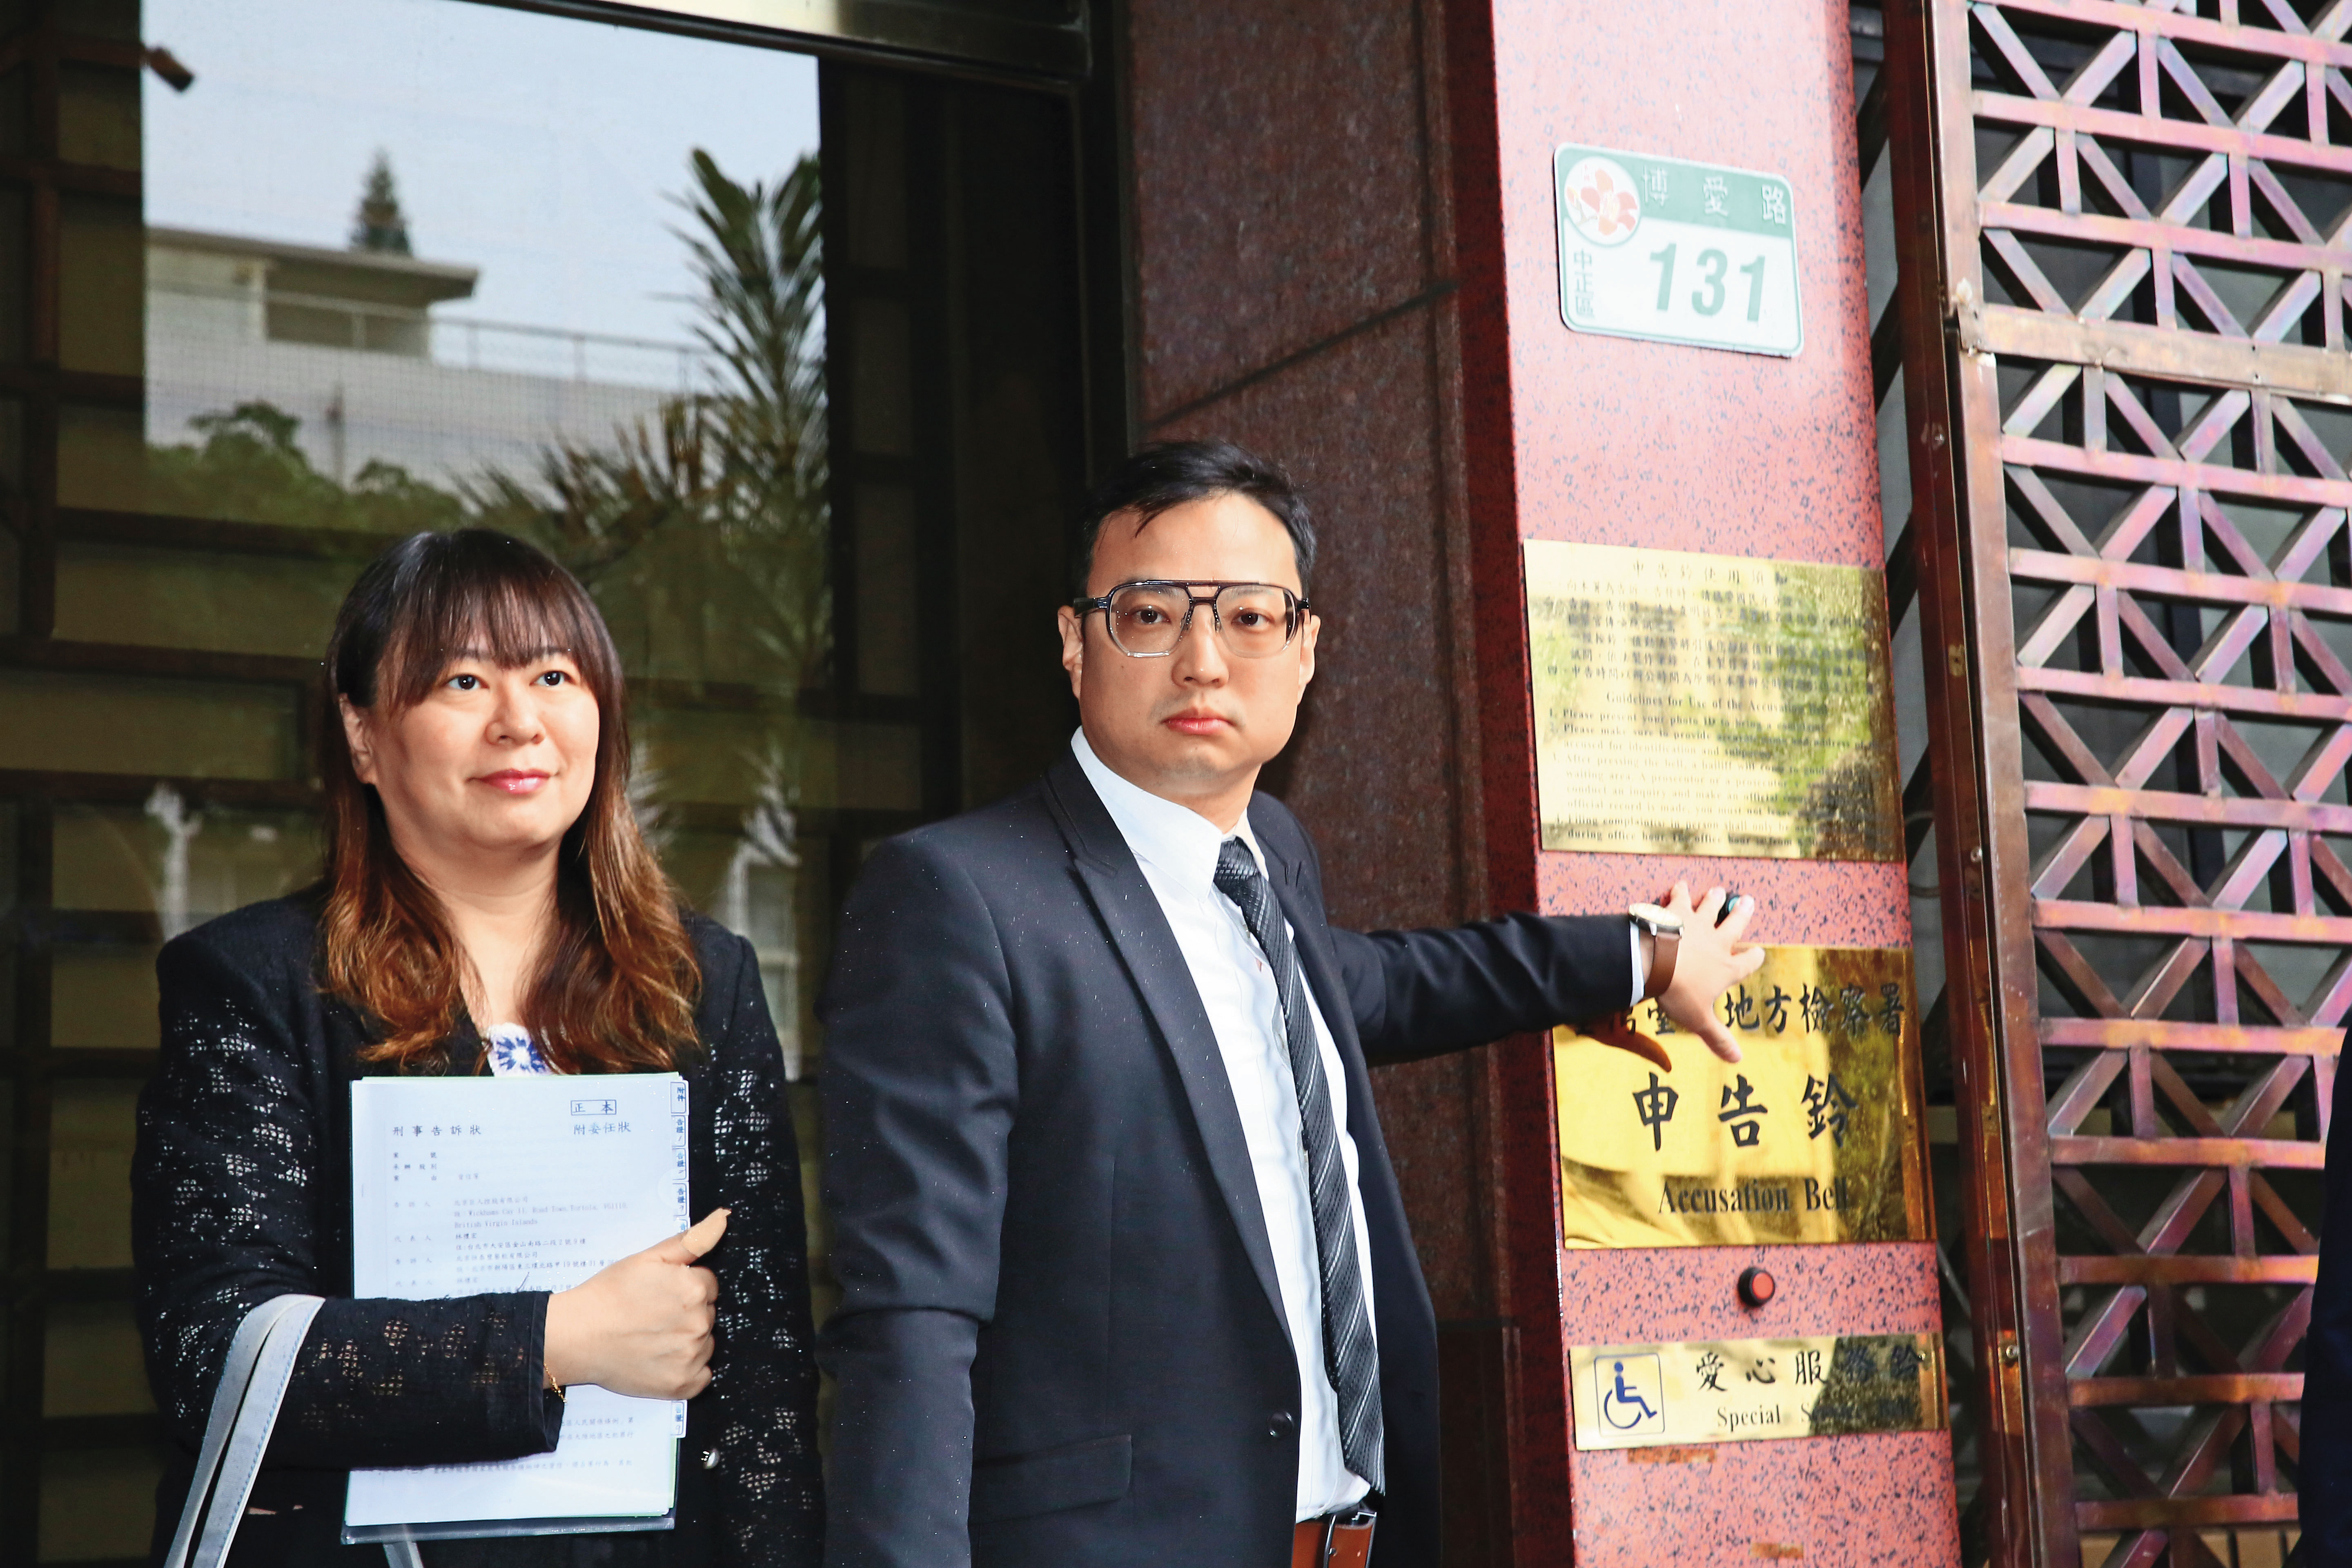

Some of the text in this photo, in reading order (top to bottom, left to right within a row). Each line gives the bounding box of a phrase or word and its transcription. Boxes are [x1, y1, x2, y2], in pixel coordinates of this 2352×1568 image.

[1641, 165, 1786, 225] 博愛路
[1574, 249, 1594, 318] 中正區
[1650, 243, 1765, 322] 131
[1607, 691, 1662, 706] Guidelines
[1668, 695, 1682, 707] for
[1689, 695, 1706, 708] Use
[1713, 697, 1722, 709] of
[1564, 708, 1594, 719] Please
[1600, 712, 1636, 723] present
[1643, 715, 1664, 726] your
[1670, 716, 1697, 727] photo
[1564, 723, 1594, 734] Please
[1601, 726, 1625, 735] make
[1659, 728, 1668, 737] to
[1674, 729, 1710, 740] provide
[1609, 740, 1623, 751] for
[1629, 740, 1695, 755] identification
[1702, 746, 1719, 755] and
[1566, 753, 1590, 764] After
[1598, 755, 1638, 768] pressing
[1645, 757, 1658, 767] the
[1666, 758, 1686, 770] bell,
[1703, 760, 1731, 771] bailiff
[1566, 769, 1603, 782] waiting
[1640, 772, 1646, 781] A
[1652, 773, 1704, 784] prosecutor
[1568, 784, 1606, 795] conduct
[1630, 786, 1665, 799] inquiry
[1673, 789, 1690, 798] and
[1696, 790, 1720, 800] make
[1568, 799, 1603, 809] official
[1610, 801, 1641, 811] record
[1648, 802, 1655, 811] is
[1696, 806, 1712, 816] you
[1718, 806, 1741, 815] must
[1747, 807, 1762, 816] not
[1568, 814, 1598, 826] Filing
[1686, 821, 1718, 831] person
[1725, 820, 1746, 831] shall
[1753, 821, 1772, 833] only
[1568, 829, 1602, 841] during
[1608, 829, 1634, 840] office
[1695, 833, 1719, 843] office
[1728, 833, 1749, 844] hour
[573, 1100, 614, 1114] 正本
[1633, 1072, 1858, 1151] 申告鈴
[393, 1125, 481, 1136] 刑事告訴狀
[574, 1121, 631, 1135] 附委任狀
[1659, 1177, 1848, 1214] Accusation Bell
[1717, 1404, 1781, 1431] Special
